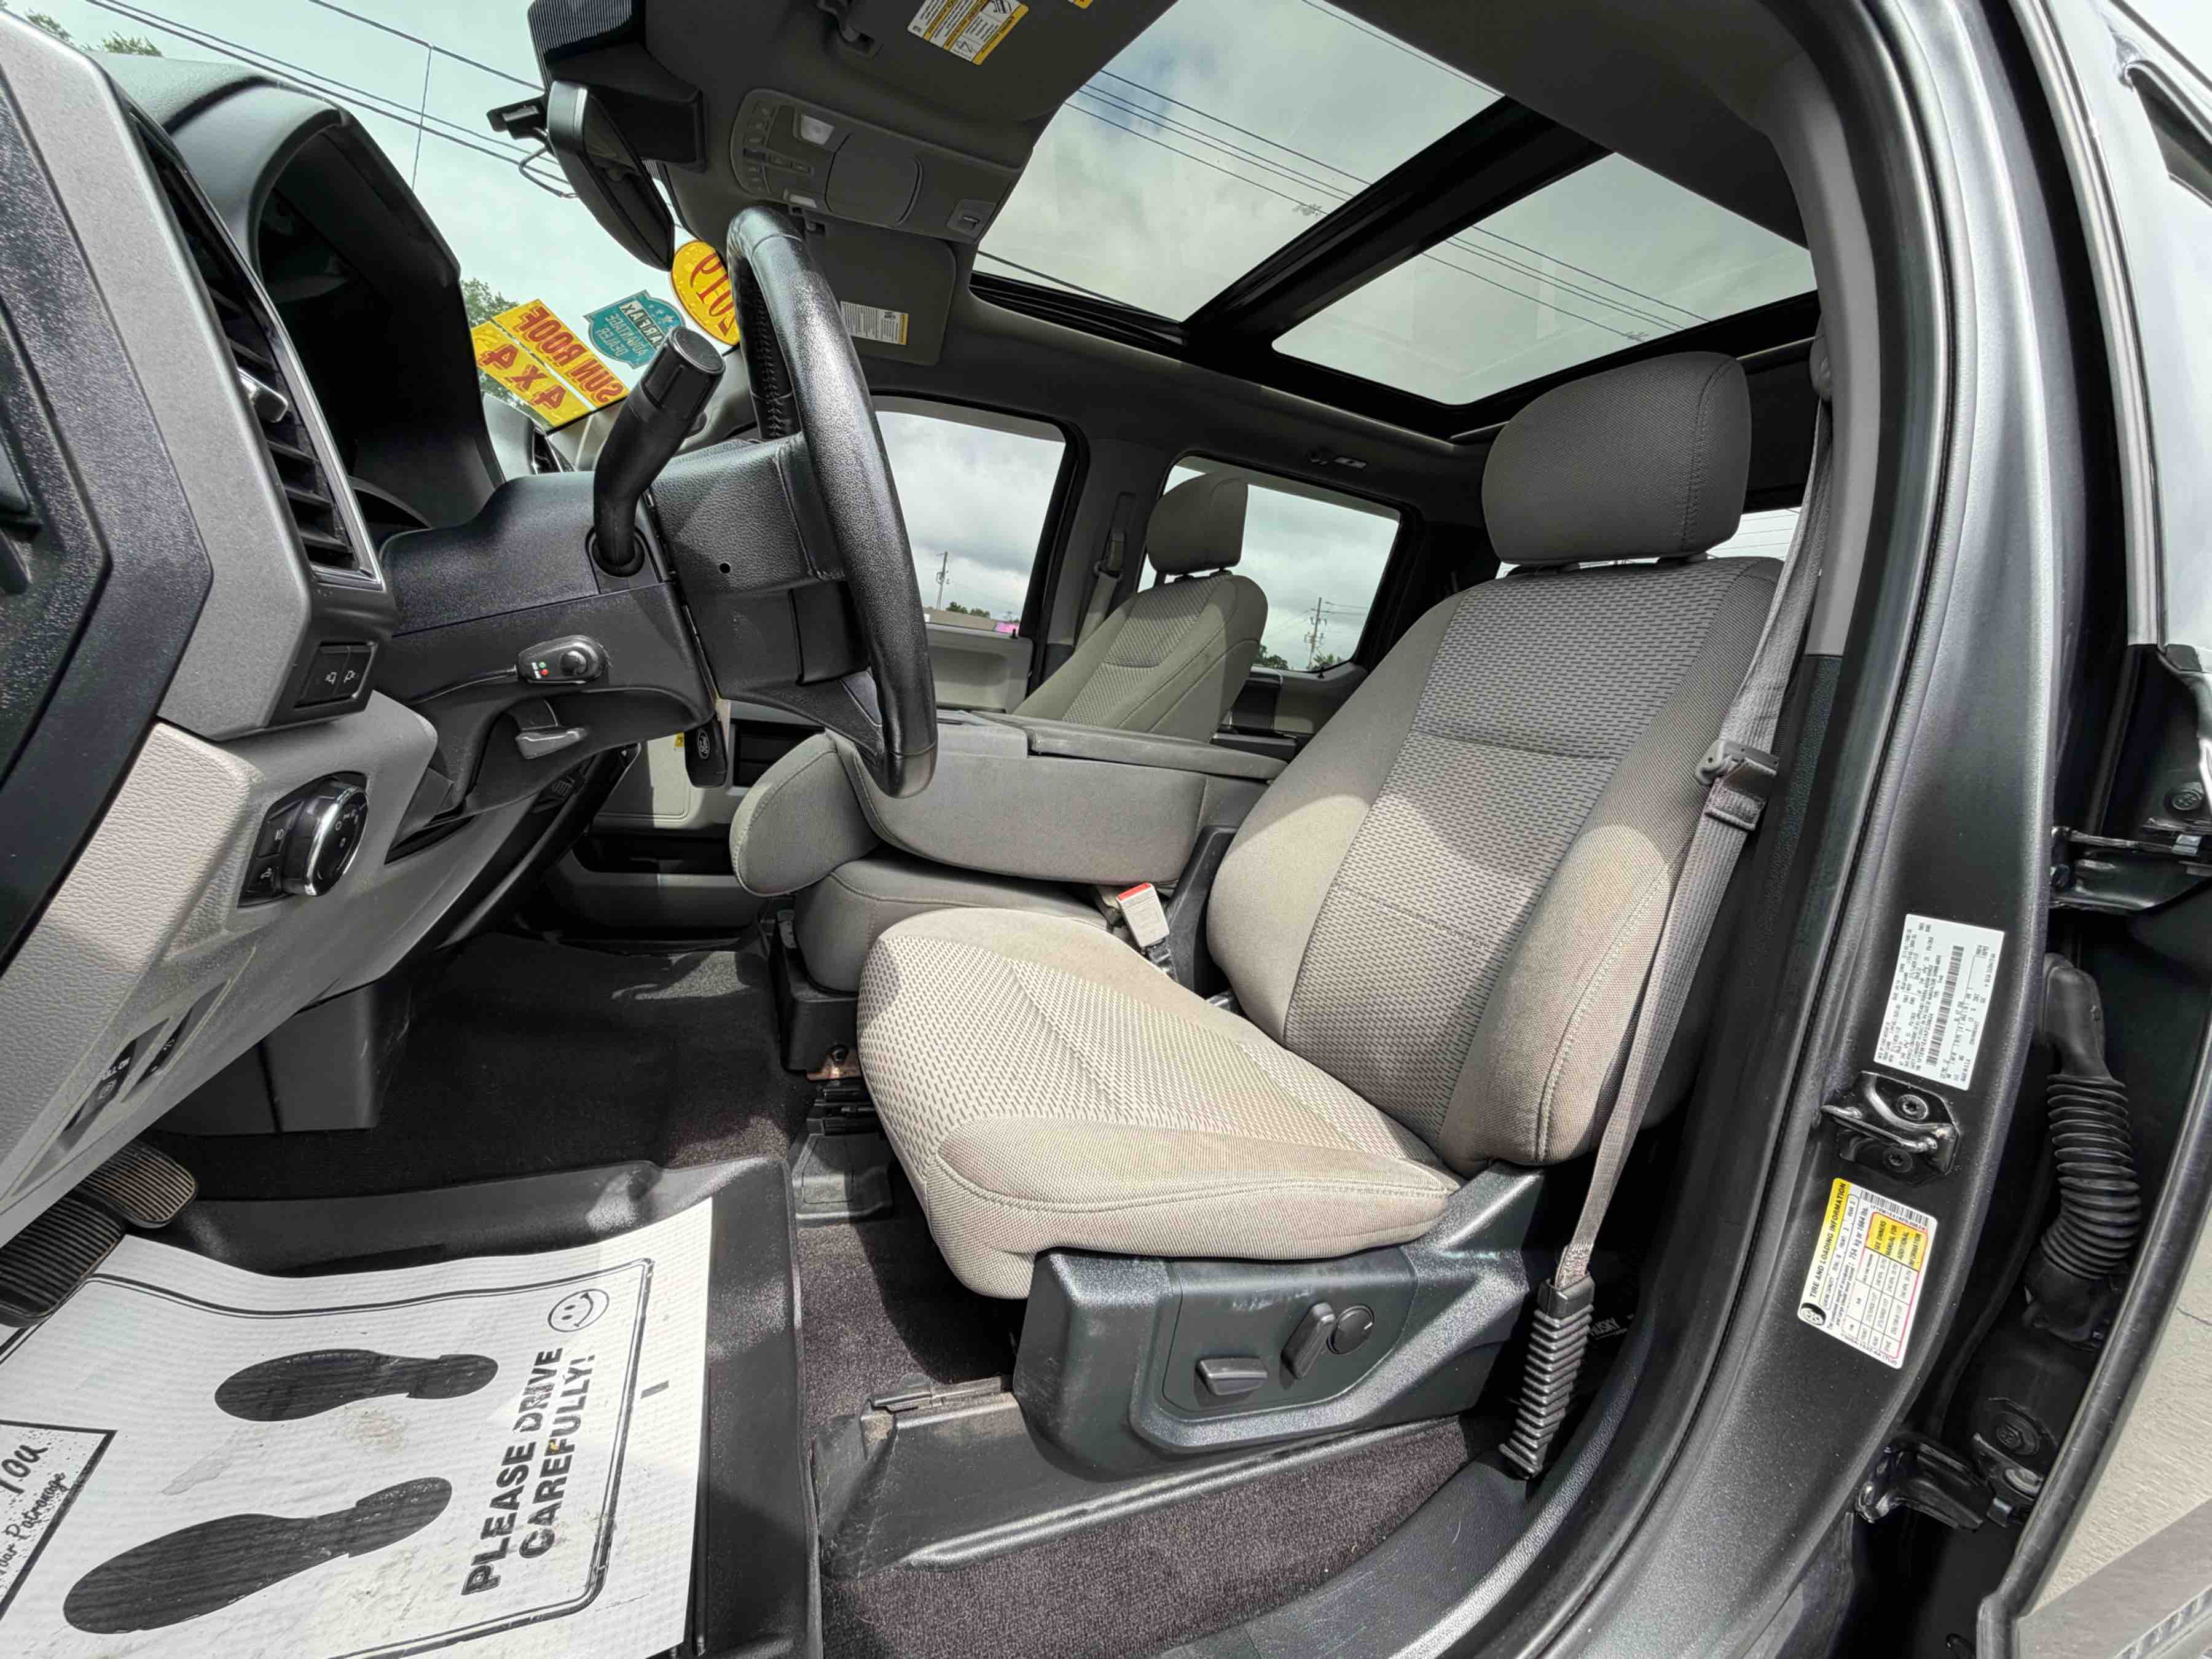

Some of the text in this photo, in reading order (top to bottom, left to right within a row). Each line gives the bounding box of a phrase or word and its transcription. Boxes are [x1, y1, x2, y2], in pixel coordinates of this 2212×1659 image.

[1809, 1281, 1819, 1299] TIRE
[1814, 1263, 1824, 1281] AND
[1819, 1231, 1834, 1265] LOADING
[1827, 1182, 1846, 1232] INFORMATION
[2, 1472, 69, 1540] Patronage
[461, 1347, 563, 1595] PLEASE DRIVE
[519, 1354, 595, 1558] CAREFULLY!
